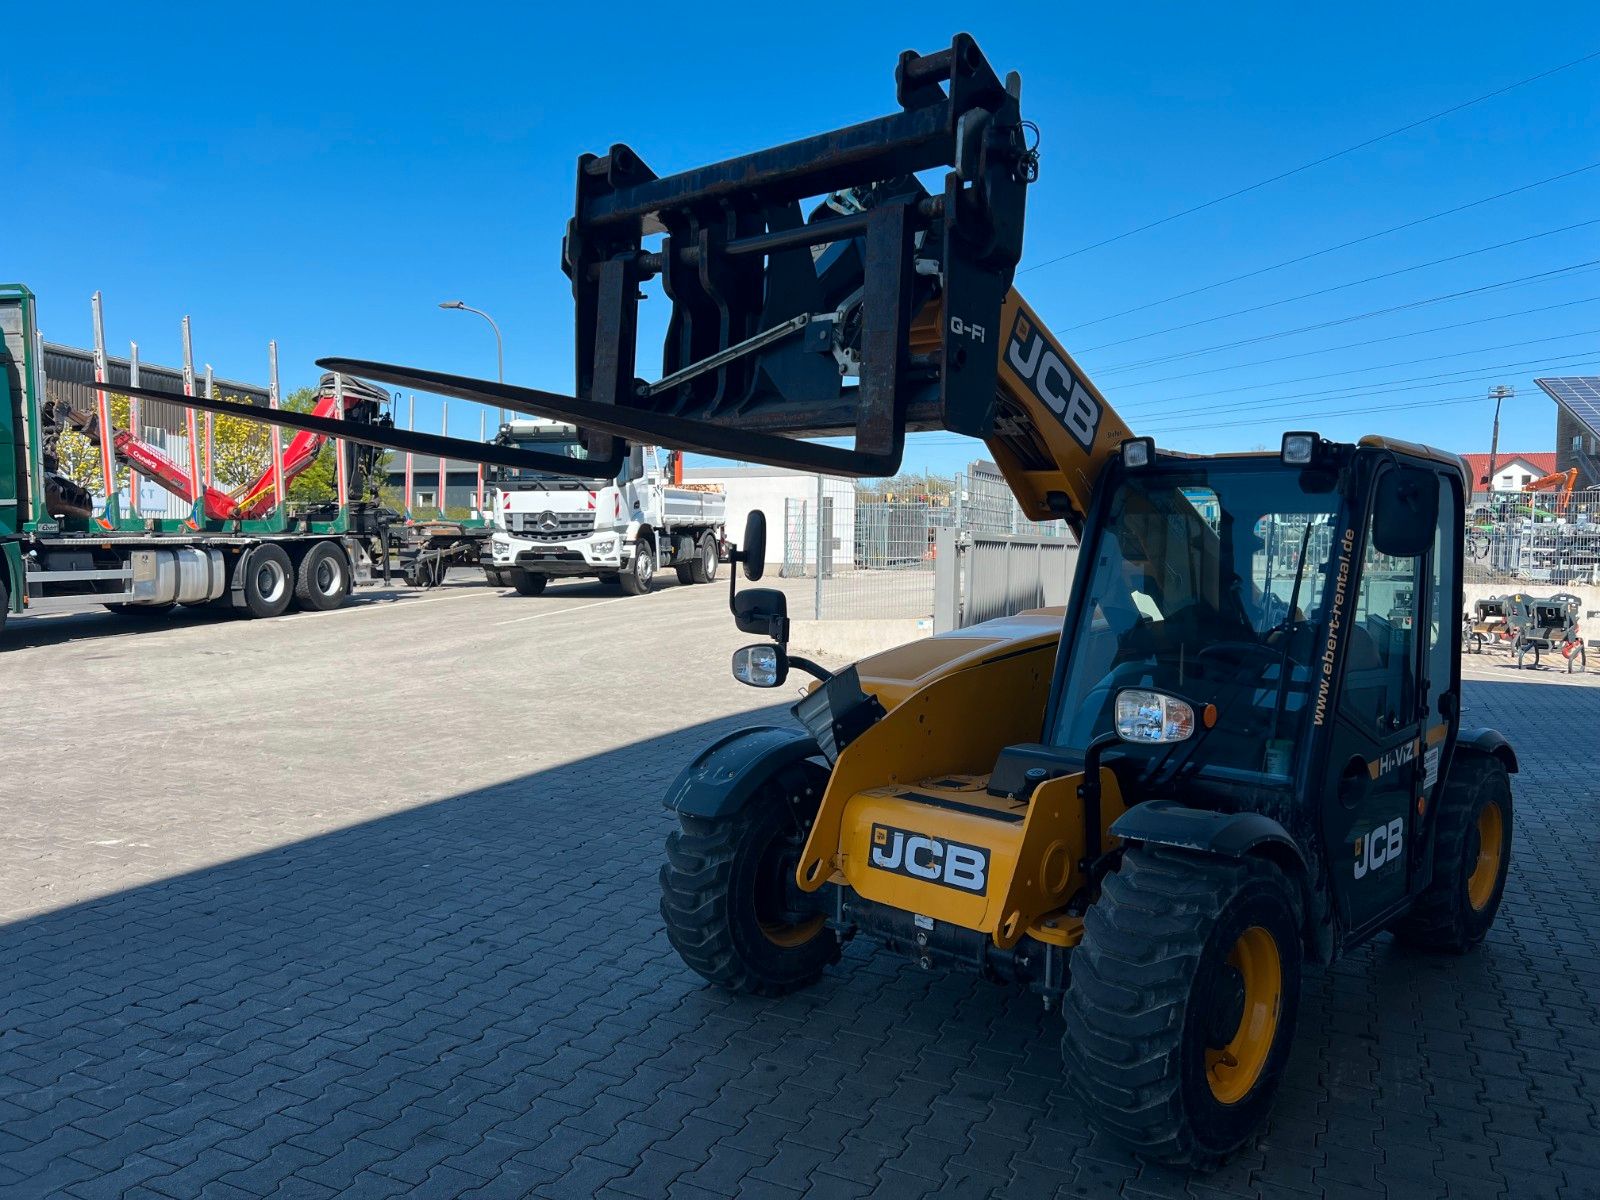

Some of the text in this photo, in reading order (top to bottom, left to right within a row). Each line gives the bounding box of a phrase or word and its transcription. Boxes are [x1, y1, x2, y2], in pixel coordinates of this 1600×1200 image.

[1009, 334, 1098, 446] JCB
[1314, 529, 1354, 726] www.ebert-rental.de
[872, 832, 986, 890] JCB
[1354, 817, 1403, 880] JCB
